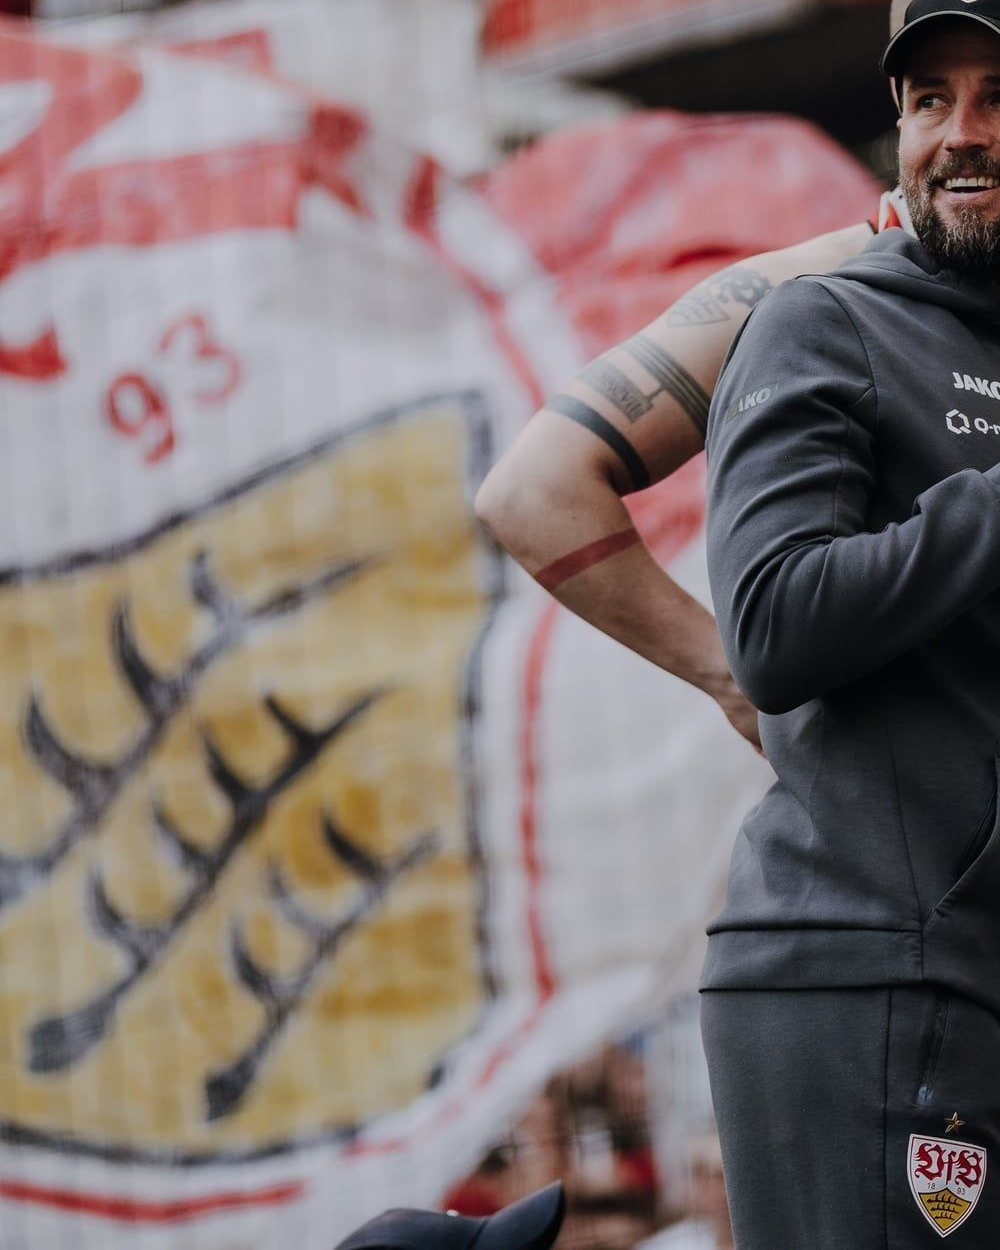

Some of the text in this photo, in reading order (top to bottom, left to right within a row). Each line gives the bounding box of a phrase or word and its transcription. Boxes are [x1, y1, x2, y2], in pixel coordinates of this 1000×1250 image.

[914, 1143, 982, 1188] VfB
[927, 1182, 936, 1190] 18
[956, 1187, 966, 1196] 93
